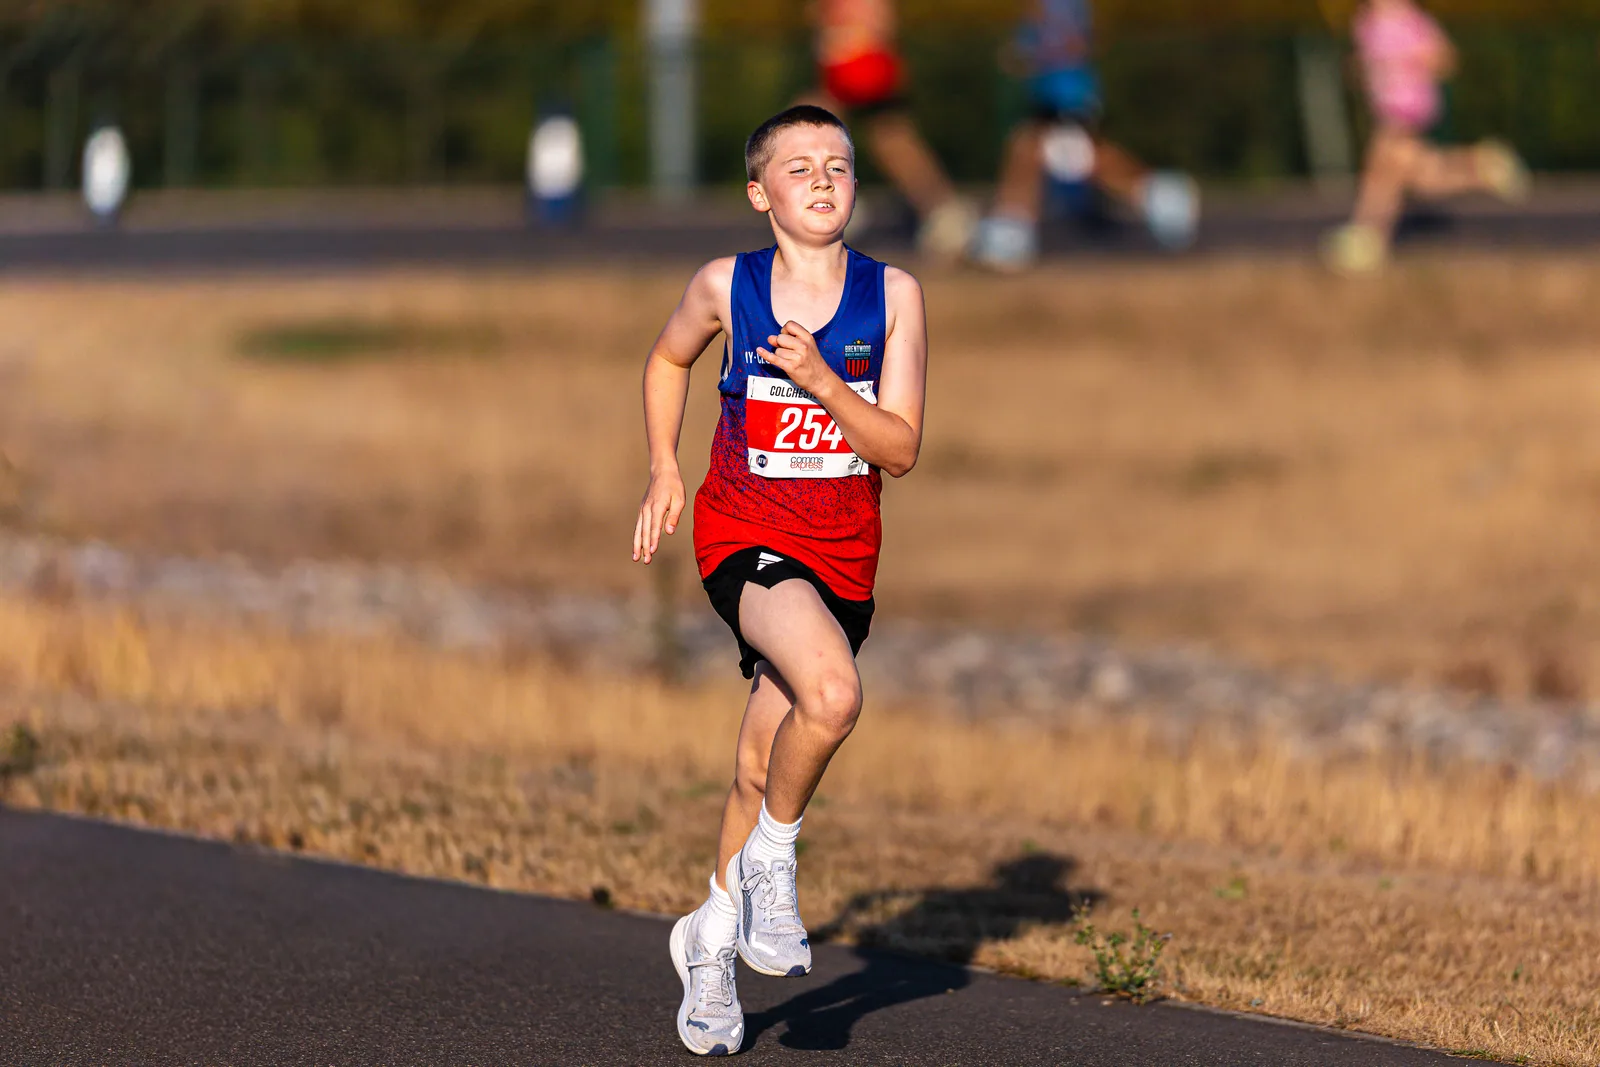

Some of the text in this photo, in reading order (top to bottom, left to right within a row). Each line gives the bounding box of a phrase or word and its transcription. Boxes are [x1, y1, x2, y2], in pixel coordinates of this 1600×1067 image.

[769, 385, 817, 399] COLCHES
[774, 407, 843, 450] 254
[790, 462, 823, 471] express
